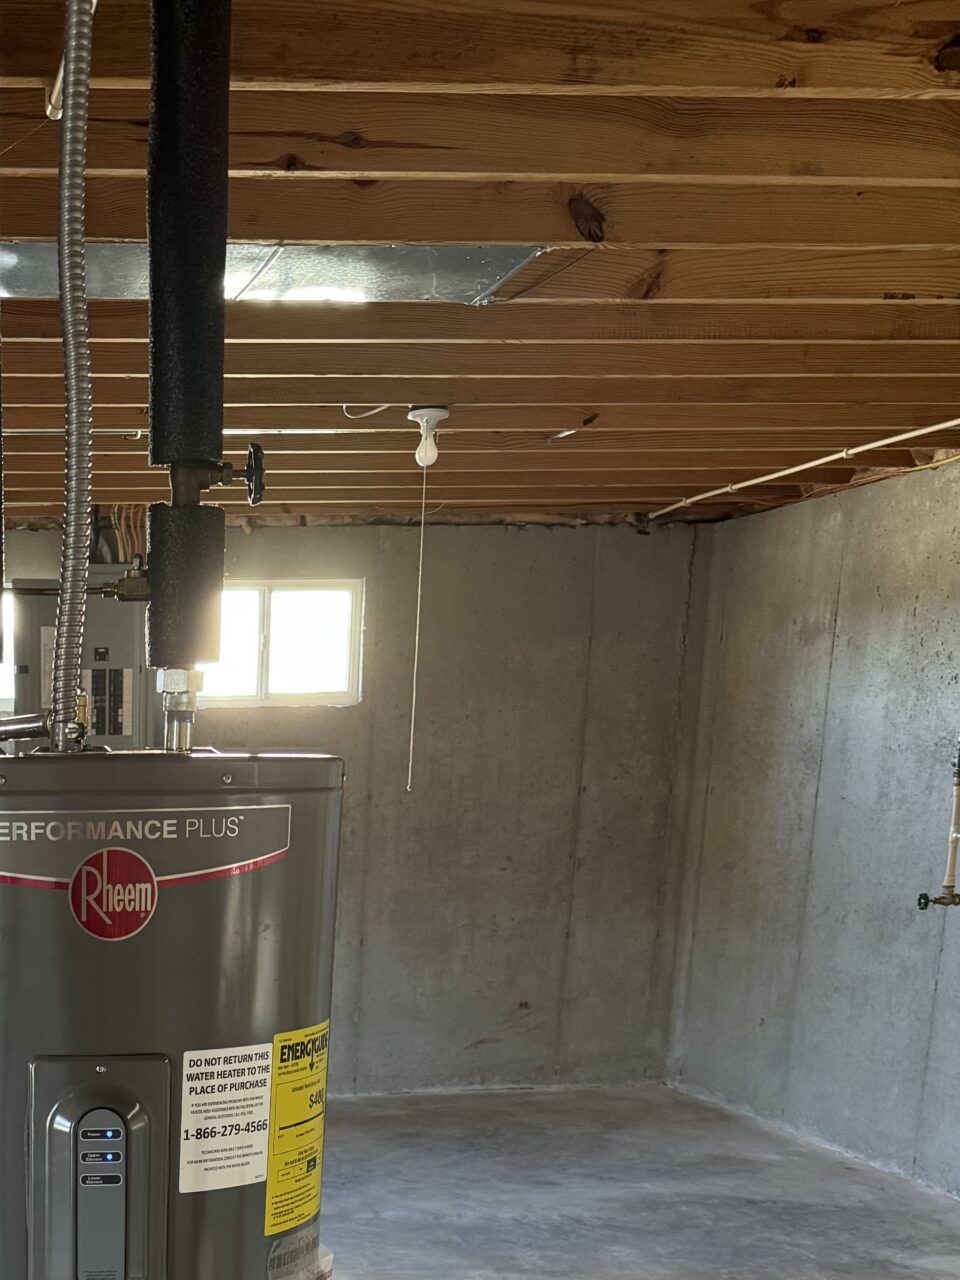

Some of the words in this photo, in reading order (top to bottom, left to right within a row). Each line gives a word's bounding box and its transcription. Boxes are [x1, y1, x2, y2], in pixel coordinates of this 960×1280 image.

[81, 850, 152, 924] Rheem
[189, 1059, 202, 1068] DO
[204, 1057, 221, 1067] NOT
[223, 1054, 253, 1065] RETURN
[254, 1051, 269, 1061] THIS
[186, 1072, 215, 1082] WATER
[217, 1068, 245, 1079] HEATER
[247, 1067, 256, 1075] TO
[257, 1065, 270, 1074] THE
[189, 1085, 215, 1095] PLACE
[217, 1084, 228, 1092] OF
[230, 1079, 267, 1091] PURCHASE
[184, 1119, 268, 1140] 1-866-279-4566
